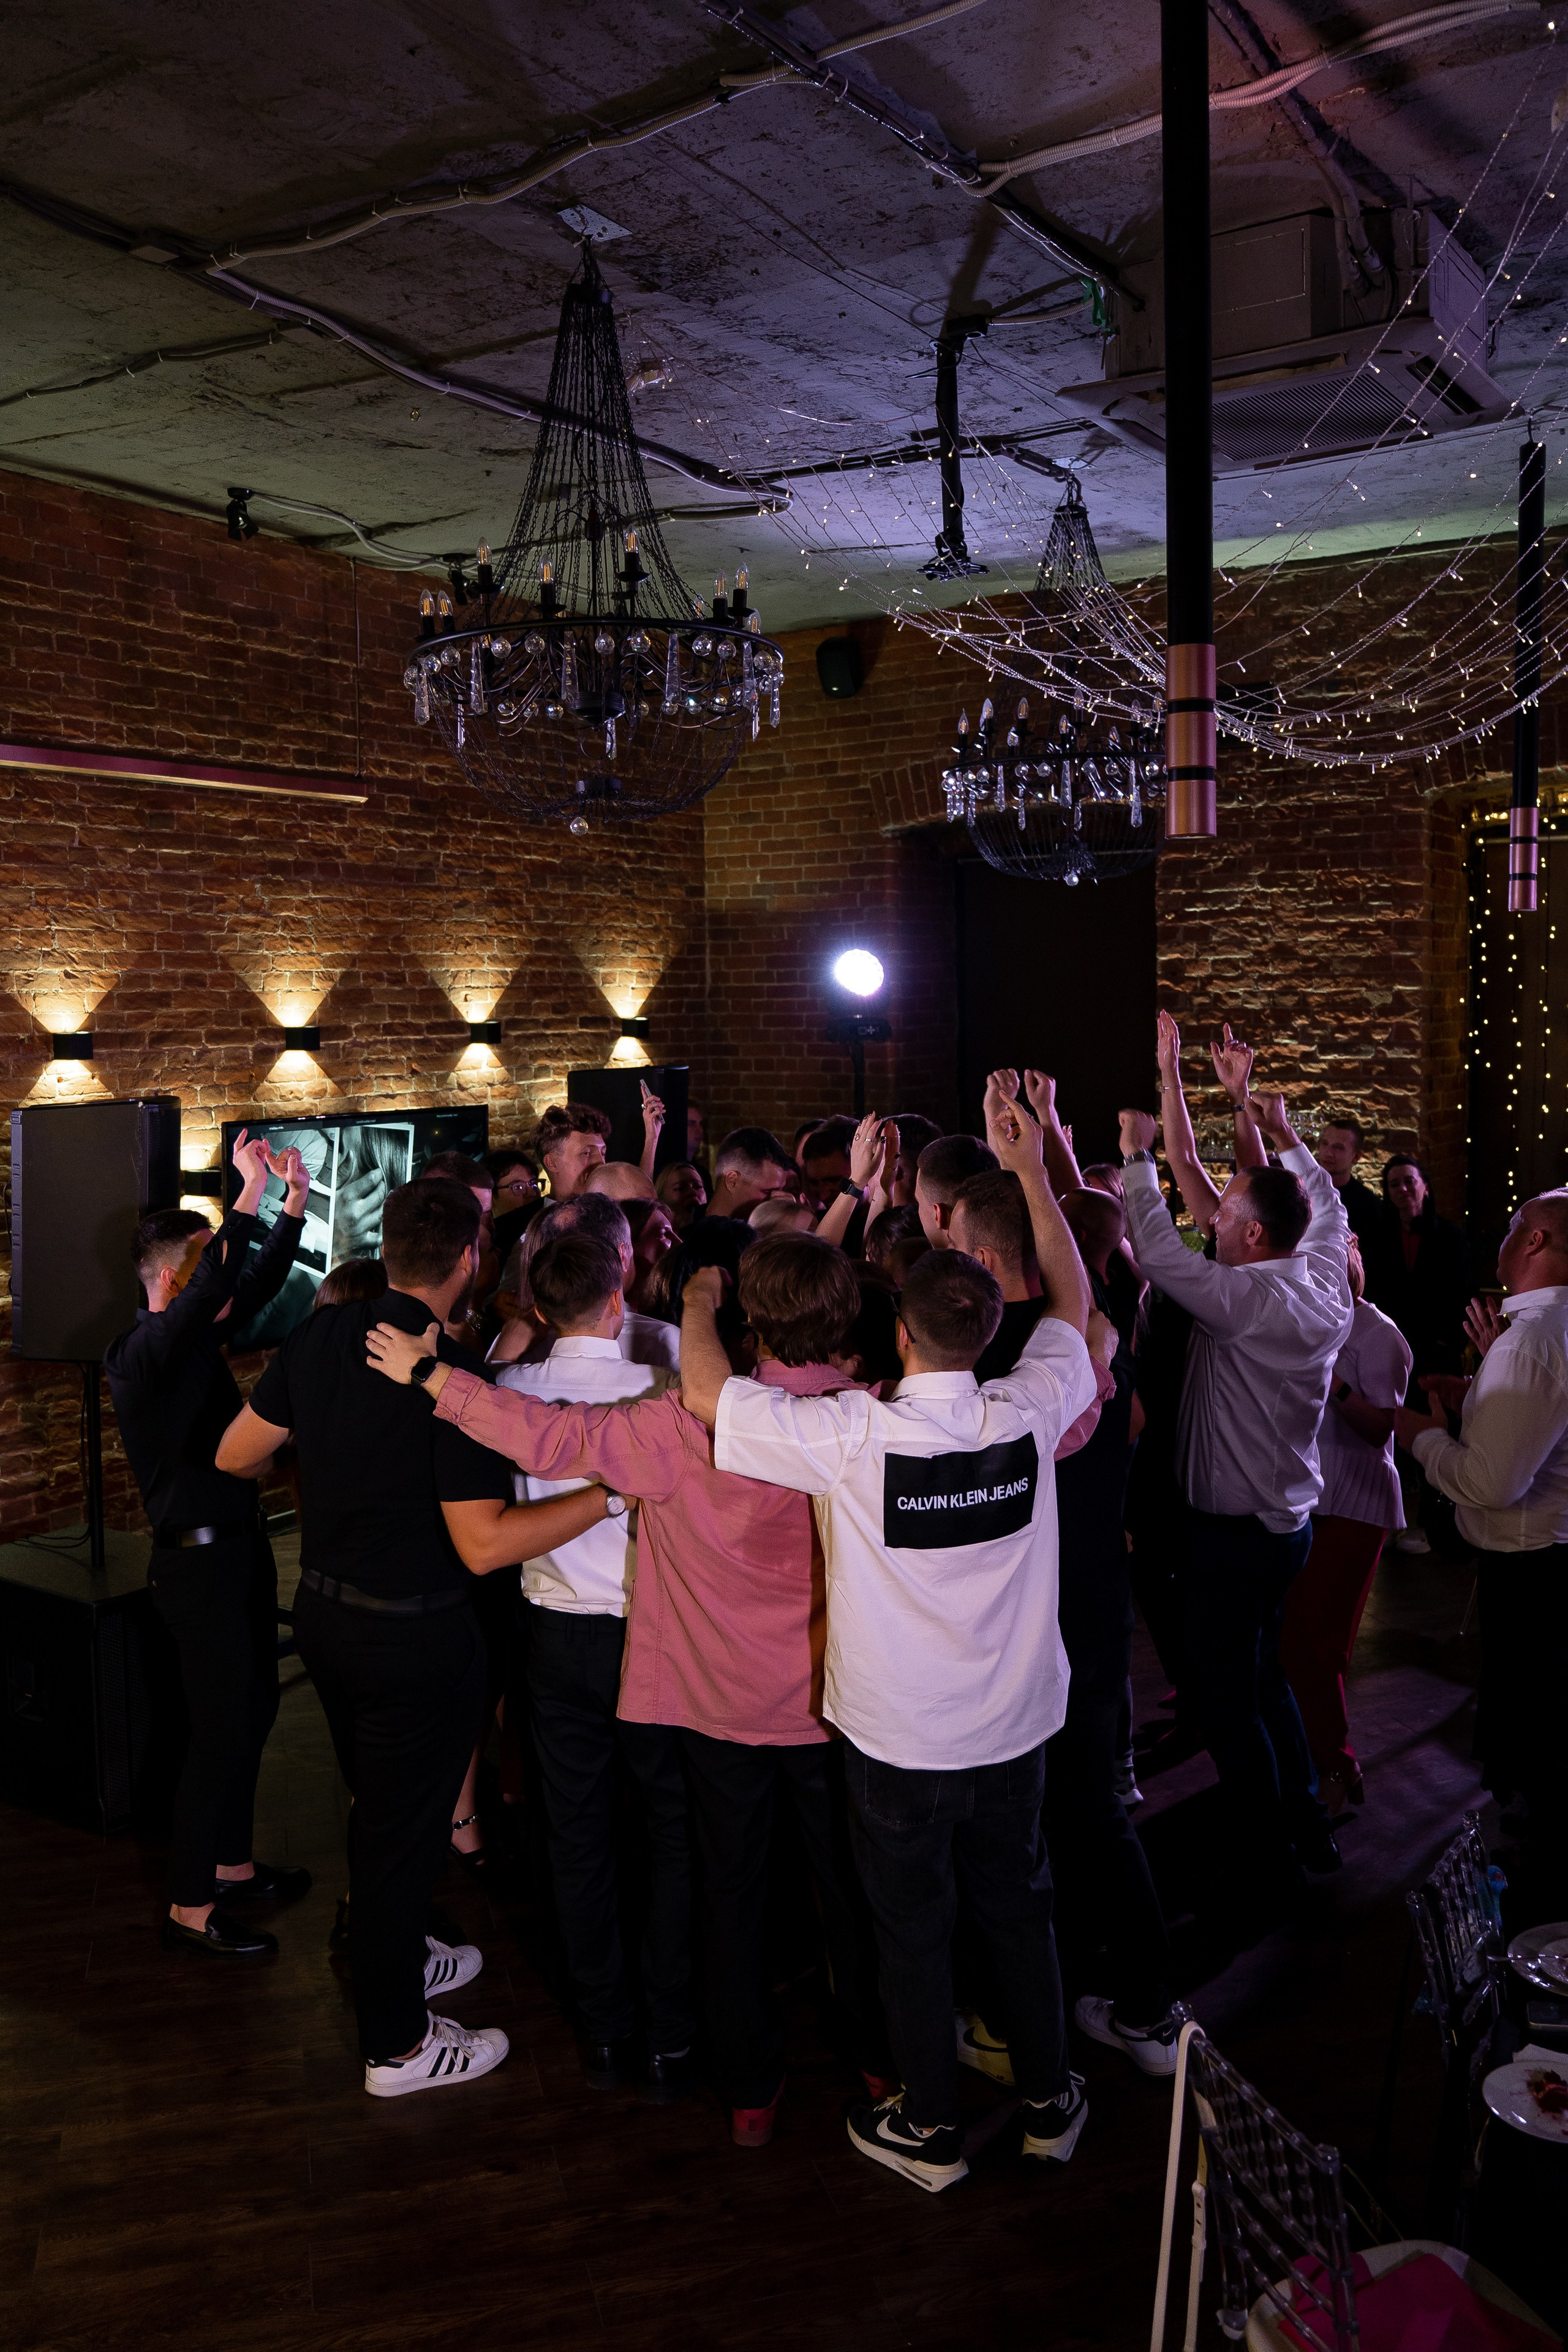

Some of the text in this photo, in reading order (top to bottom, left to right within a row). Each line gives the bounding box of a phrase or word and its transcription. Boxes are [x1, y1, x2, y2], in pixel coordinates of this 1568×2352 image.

[897, 1477, 1028, 1510] CALVIN KLEIN JEANS
